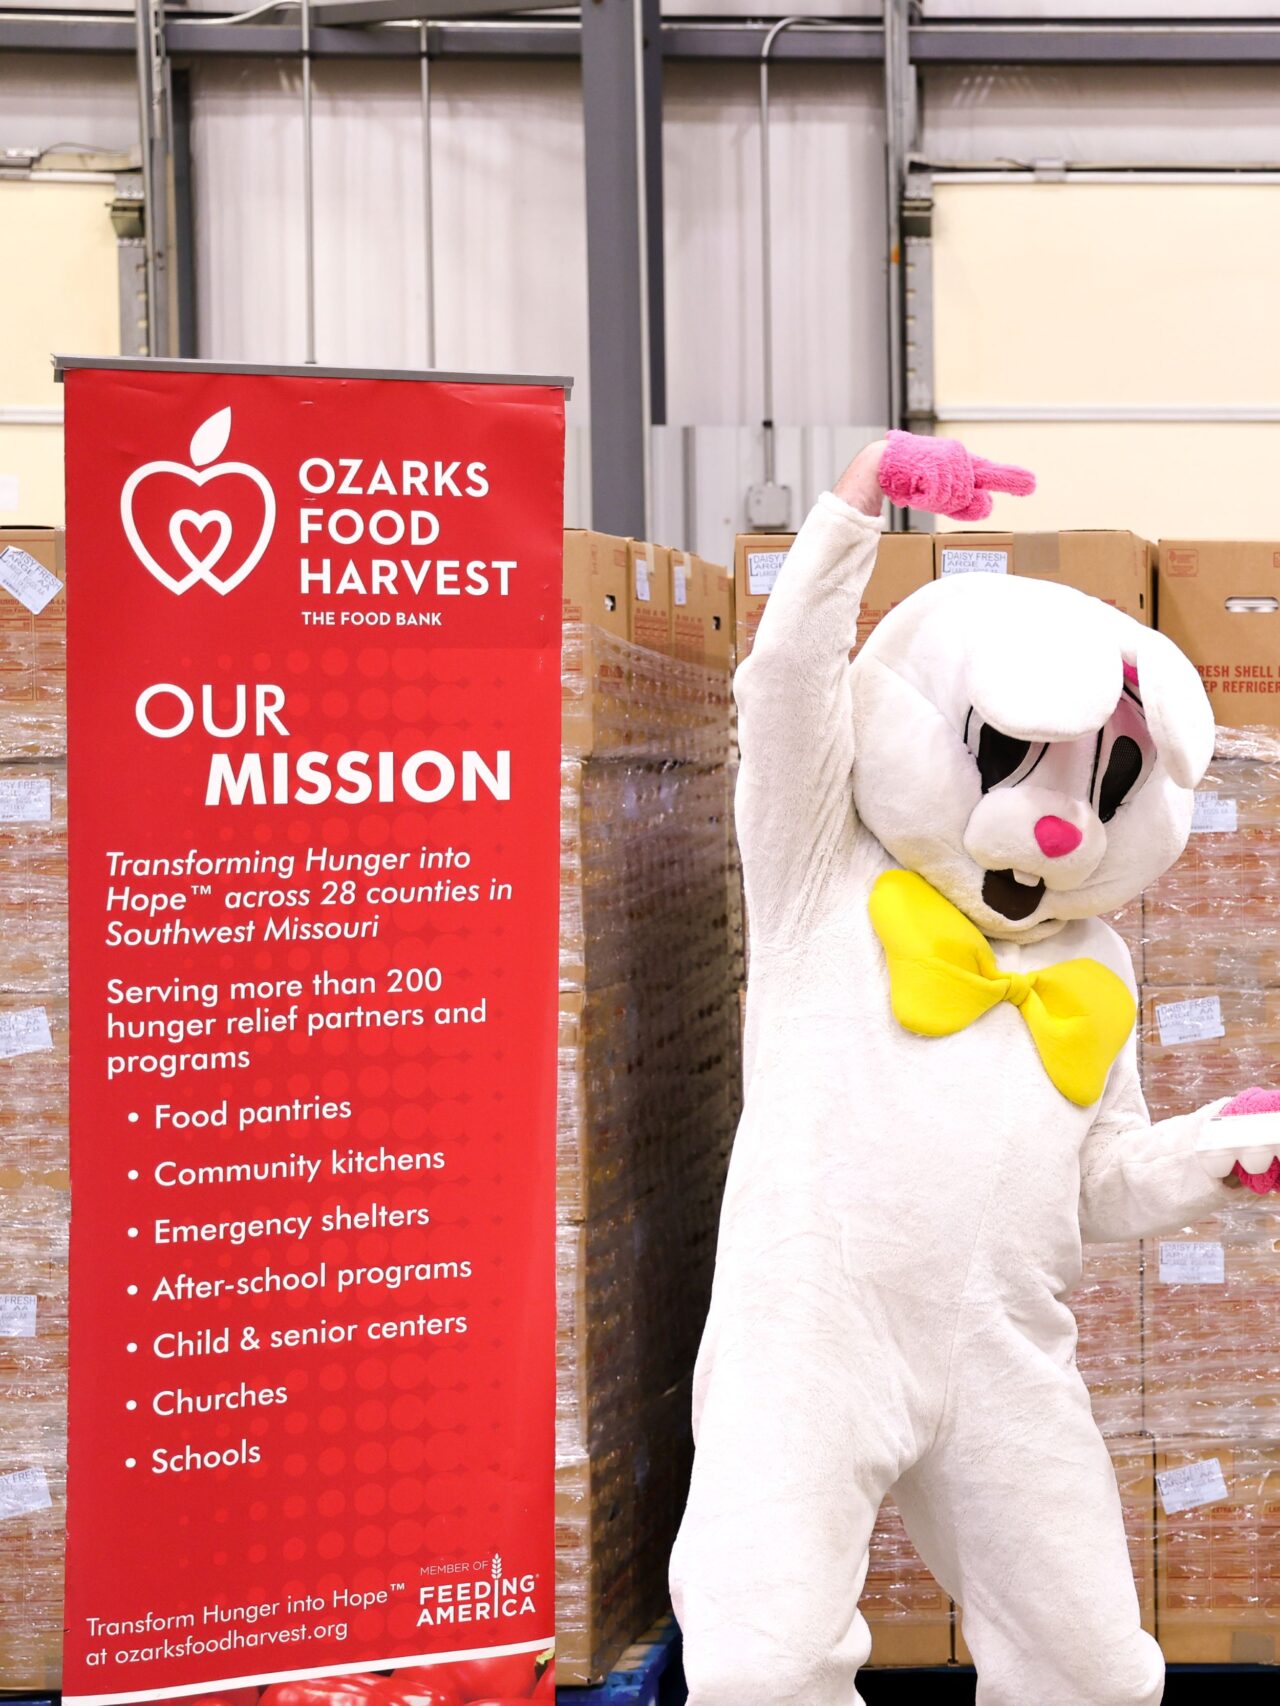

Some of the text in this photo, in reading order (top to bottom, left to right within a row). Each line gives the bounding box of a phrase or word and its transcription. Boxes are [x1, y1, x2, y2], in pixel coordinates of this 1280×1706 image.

[299, 458, 488, 497] OZARKS
[301, 508, 439, 545] FOOD
[754, 554, 780, 564] DAISY
[947, 552, 1006, 561] DAISY FRESH
[301, 559, 517, 595] HARVEST
[302, 612, 441, 625] THE FOOD BANK
[1195, 666, 1229, 678] RESH
[1235, 666, 1273, 678] SHELL
[1204, 682, 1218, 693] EP
[136, 684, 289, 738] OUR
[205, 750, 510, 805] MISSION
[107, 847, 470, 878] Transforming Hunger into
[225, 890, 310, 908] across
[321, 881, 355, 904] 28
[367, 880, 479, 903] counties
[490, 878, 512, 900] in
[106, 915, 379, 946] Southwest Missouri
[108, 968, 441, 1007] Serving more than 200
[108, 998, 485, 1043] hunger relief partners and
[108, 1051, 249, 1079] programs
[156, 1096, 351, 1131] Food pantries
[155, 1147, 444, 1186] Community kitchens
[156, 1203, 429, 1244] Emergency shelters
[153, 1261, 471, 1301] After-school programs
[154, 1315, 467, 1358] Child & senior centers
[153, 1383, 287, 1415] Churches
[152, 1439, 260, 1473] Schools
[420, 1561, 488, 1575] MEMBER OF
[420, 1575, 535, 1605] FEEDING
[86, 1612, 194, 1636] Transform
[204, 1603, 279, 1623] Hunger
[288, 1596, 324, 1613] into
[417, 1596, 535, 1626] AMERICA
[86, 1622, 347, 1665] at ozarksfoodharvest.org
